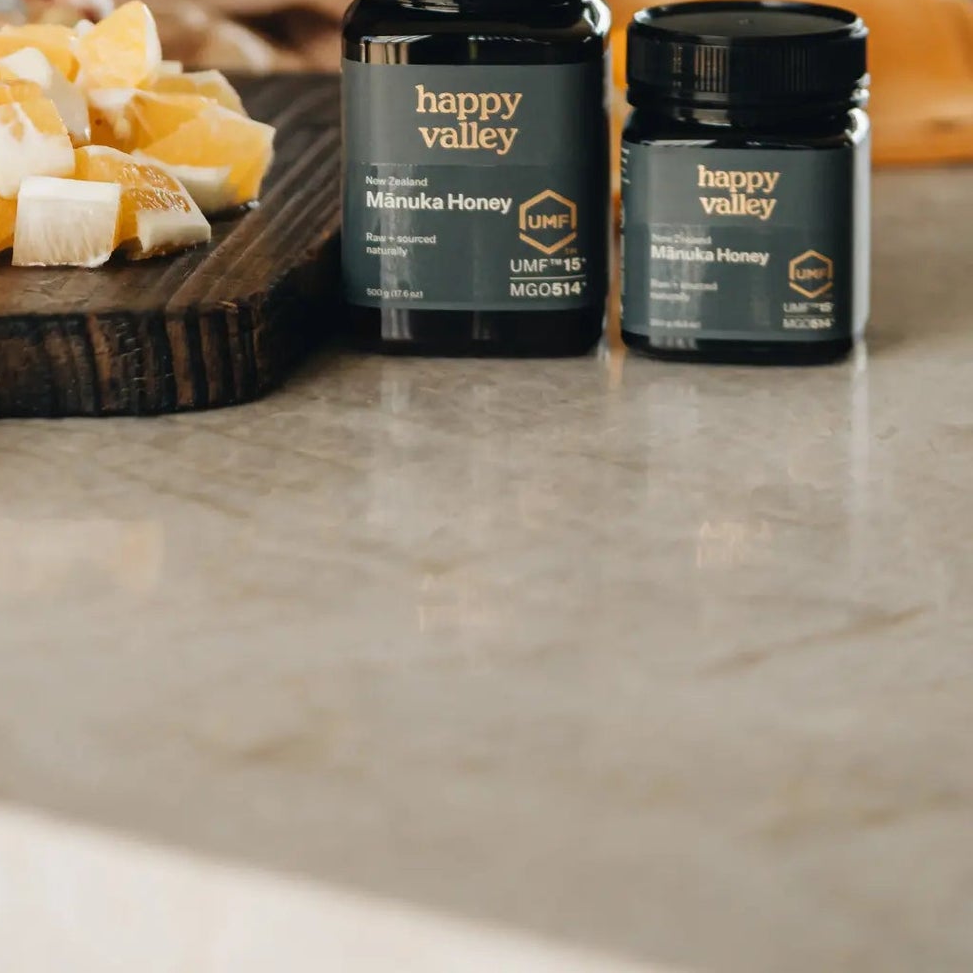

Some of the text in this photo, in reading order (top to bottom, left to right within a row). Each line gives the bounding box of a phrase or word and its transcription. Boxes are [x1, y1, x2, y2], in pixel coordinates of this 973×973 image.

[415, 83, 523, 121] happy
[418, 122, 518, 156] valley
[365, 176, 428, 187] New Zealand
[697, 164, 780, 192] happy
[366, 190, 513, 214] Mānuka Honey
[699, 193, 777, 221] valley
[528, 214, 570, 230] UMF
[365, 232, 386, 243] Raw
[397, 233, 437, 244] sourced
[366, 246, 408, 257] naturally
[717, 247, 770, 267] Honey
